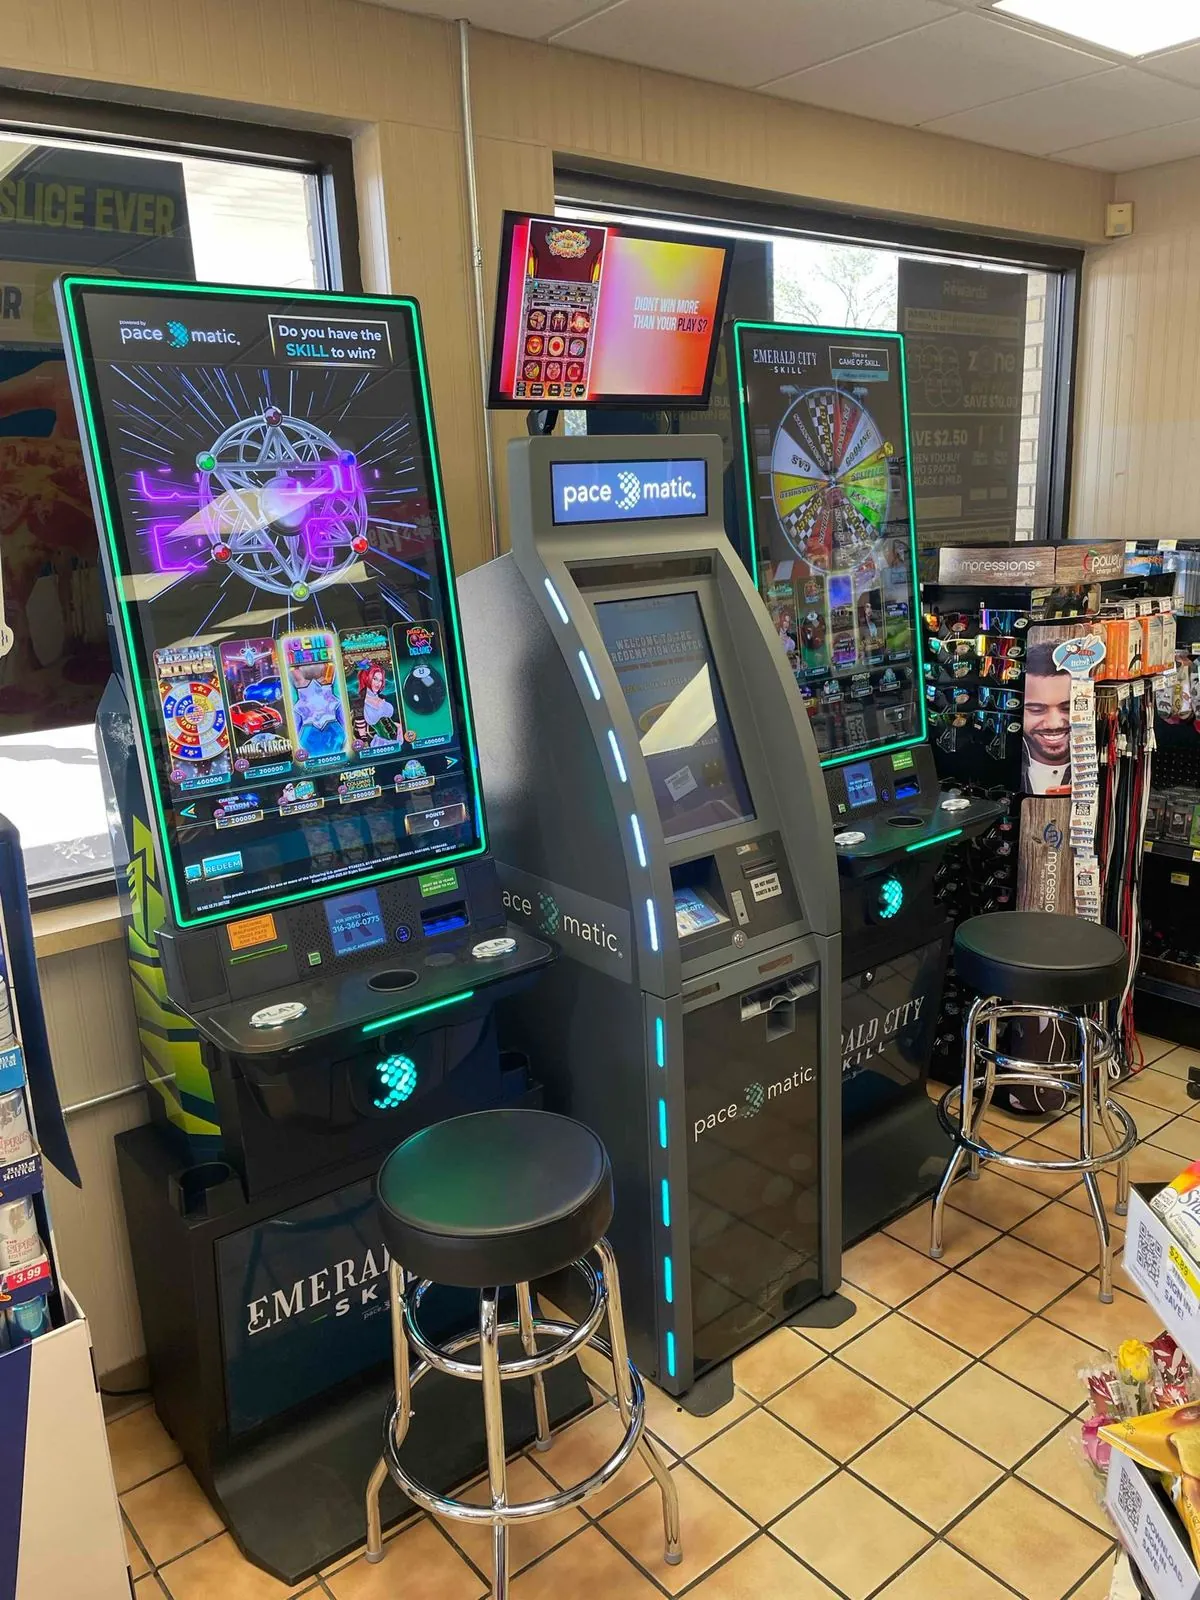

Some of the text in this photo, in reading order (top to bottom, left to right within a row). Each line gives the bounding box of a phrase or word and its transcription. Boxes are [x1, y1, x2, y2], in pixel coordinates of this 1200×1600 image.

[95, 188, 175, 237] EVER
[677, 300, 701, 315] MORE
[278, 324, 382, 341] Do you have the
[633, 314, 655, 329] THAN
[657, 316, 677, 332] YOUR
[677, 317, 697, 333] PLAY
[120, 327, 163, 345] pace
[285, 343, 377, 360] SKILL to win?
[752, 348, 818, 366] EMERALD CITY
[773, 365, 803, 375] SKILL
[838, 358, 856, 366] GAME
[856, 358, 864, 366] OF
[790, 454, 812, 473] GAS
[563, 475, 697, 512] pace matic.
[616, 634, 658, 651] WELCOME
[661, 632, 674, 643] TO
[610, 645, 668, 663] REDEMPTION
[432, 819, 440, 828] 0
[205, 860, 241, 875] REDEEM
[502, 890, 532, 916] ace
[256, 1003, 296, 1020] PLAY
[883, 995, 925, 1035] CITY
[693, 1103, 738, 1143] pace
[246, 1242, 391, 1336] EMERA
[1166, 1275, 1183, 1302] SIGN
